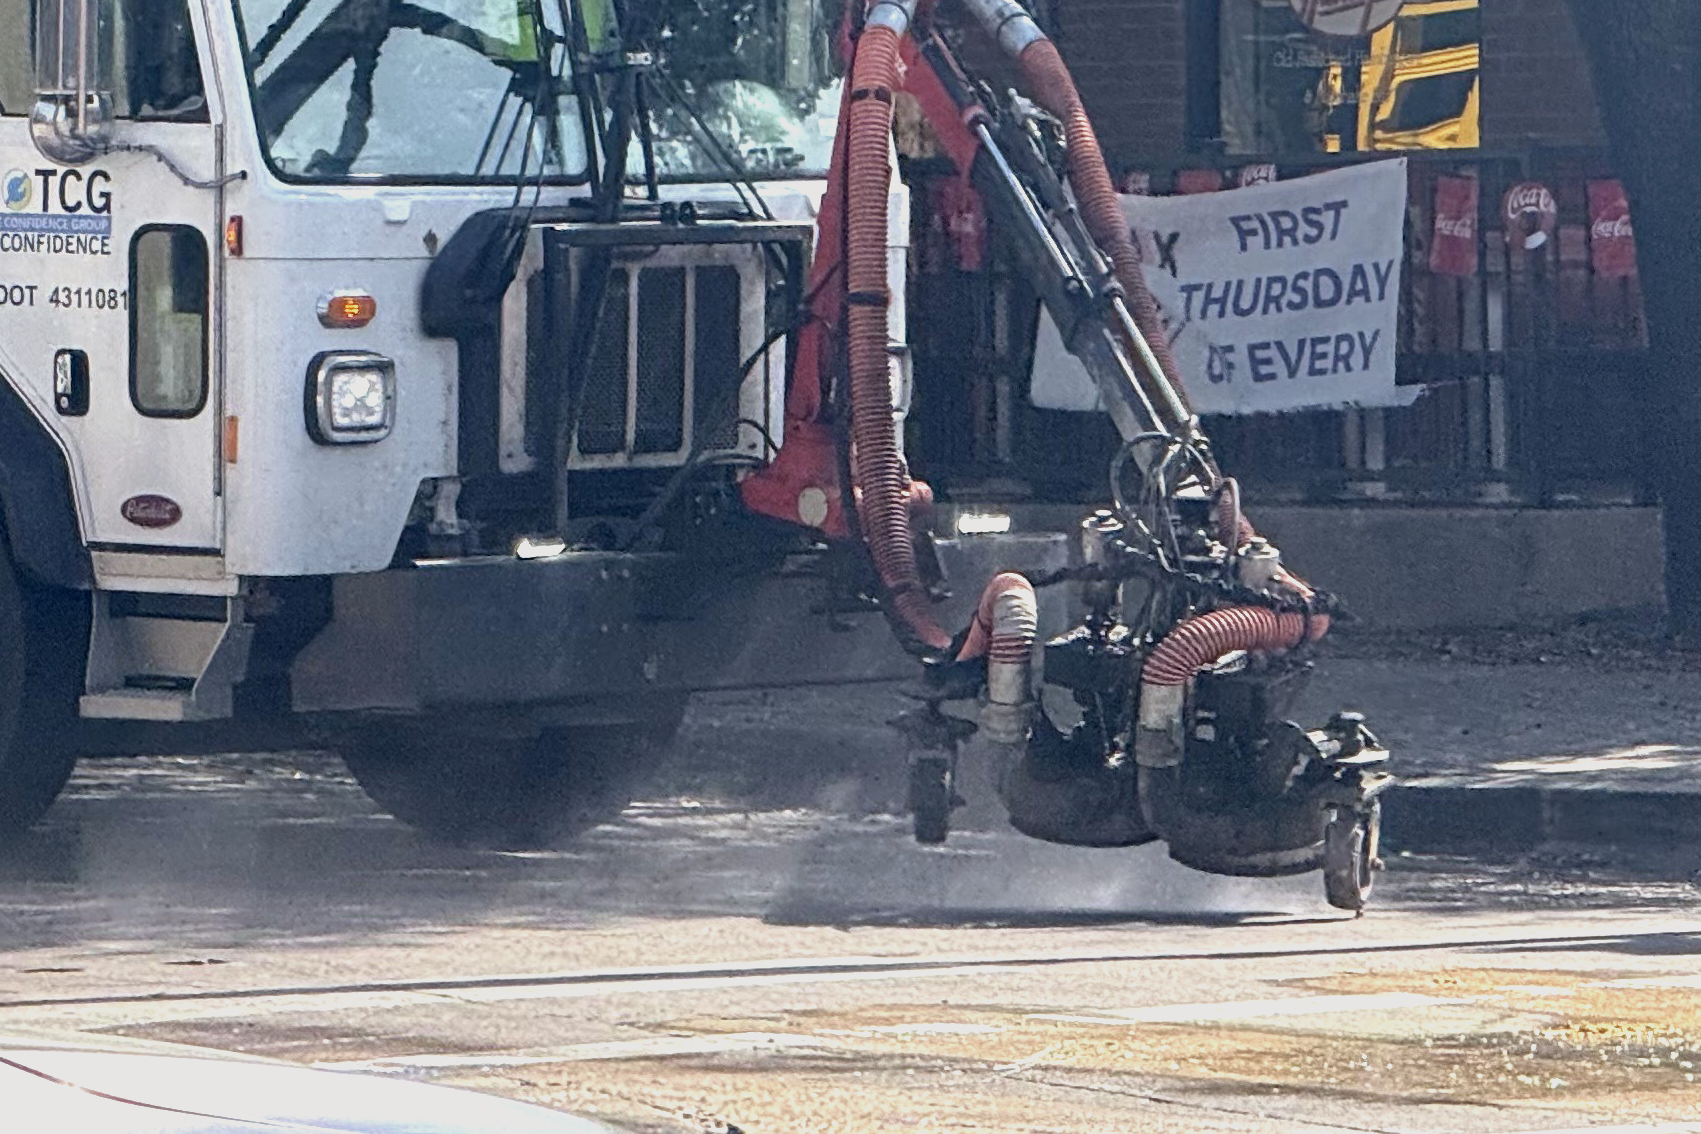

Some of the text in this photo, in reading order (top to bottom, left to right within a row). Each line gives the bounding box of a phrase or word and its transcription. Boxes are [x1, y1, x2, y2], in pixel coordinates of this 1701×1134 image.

[35, 169, 111, 214] TCG
[0, 233, 111, 255] CONFIDENCE
[4, 216, 69, 231] CONFIDENCE
[71, 218, 109, 231] GROUP
[1229, 199, 1348, 252] FIRST
[49, 286, 128, 310] 4311081
[1180, 259, 1394, 322] THURSDAY
[1247, 329, 1380, 383] EVERY
